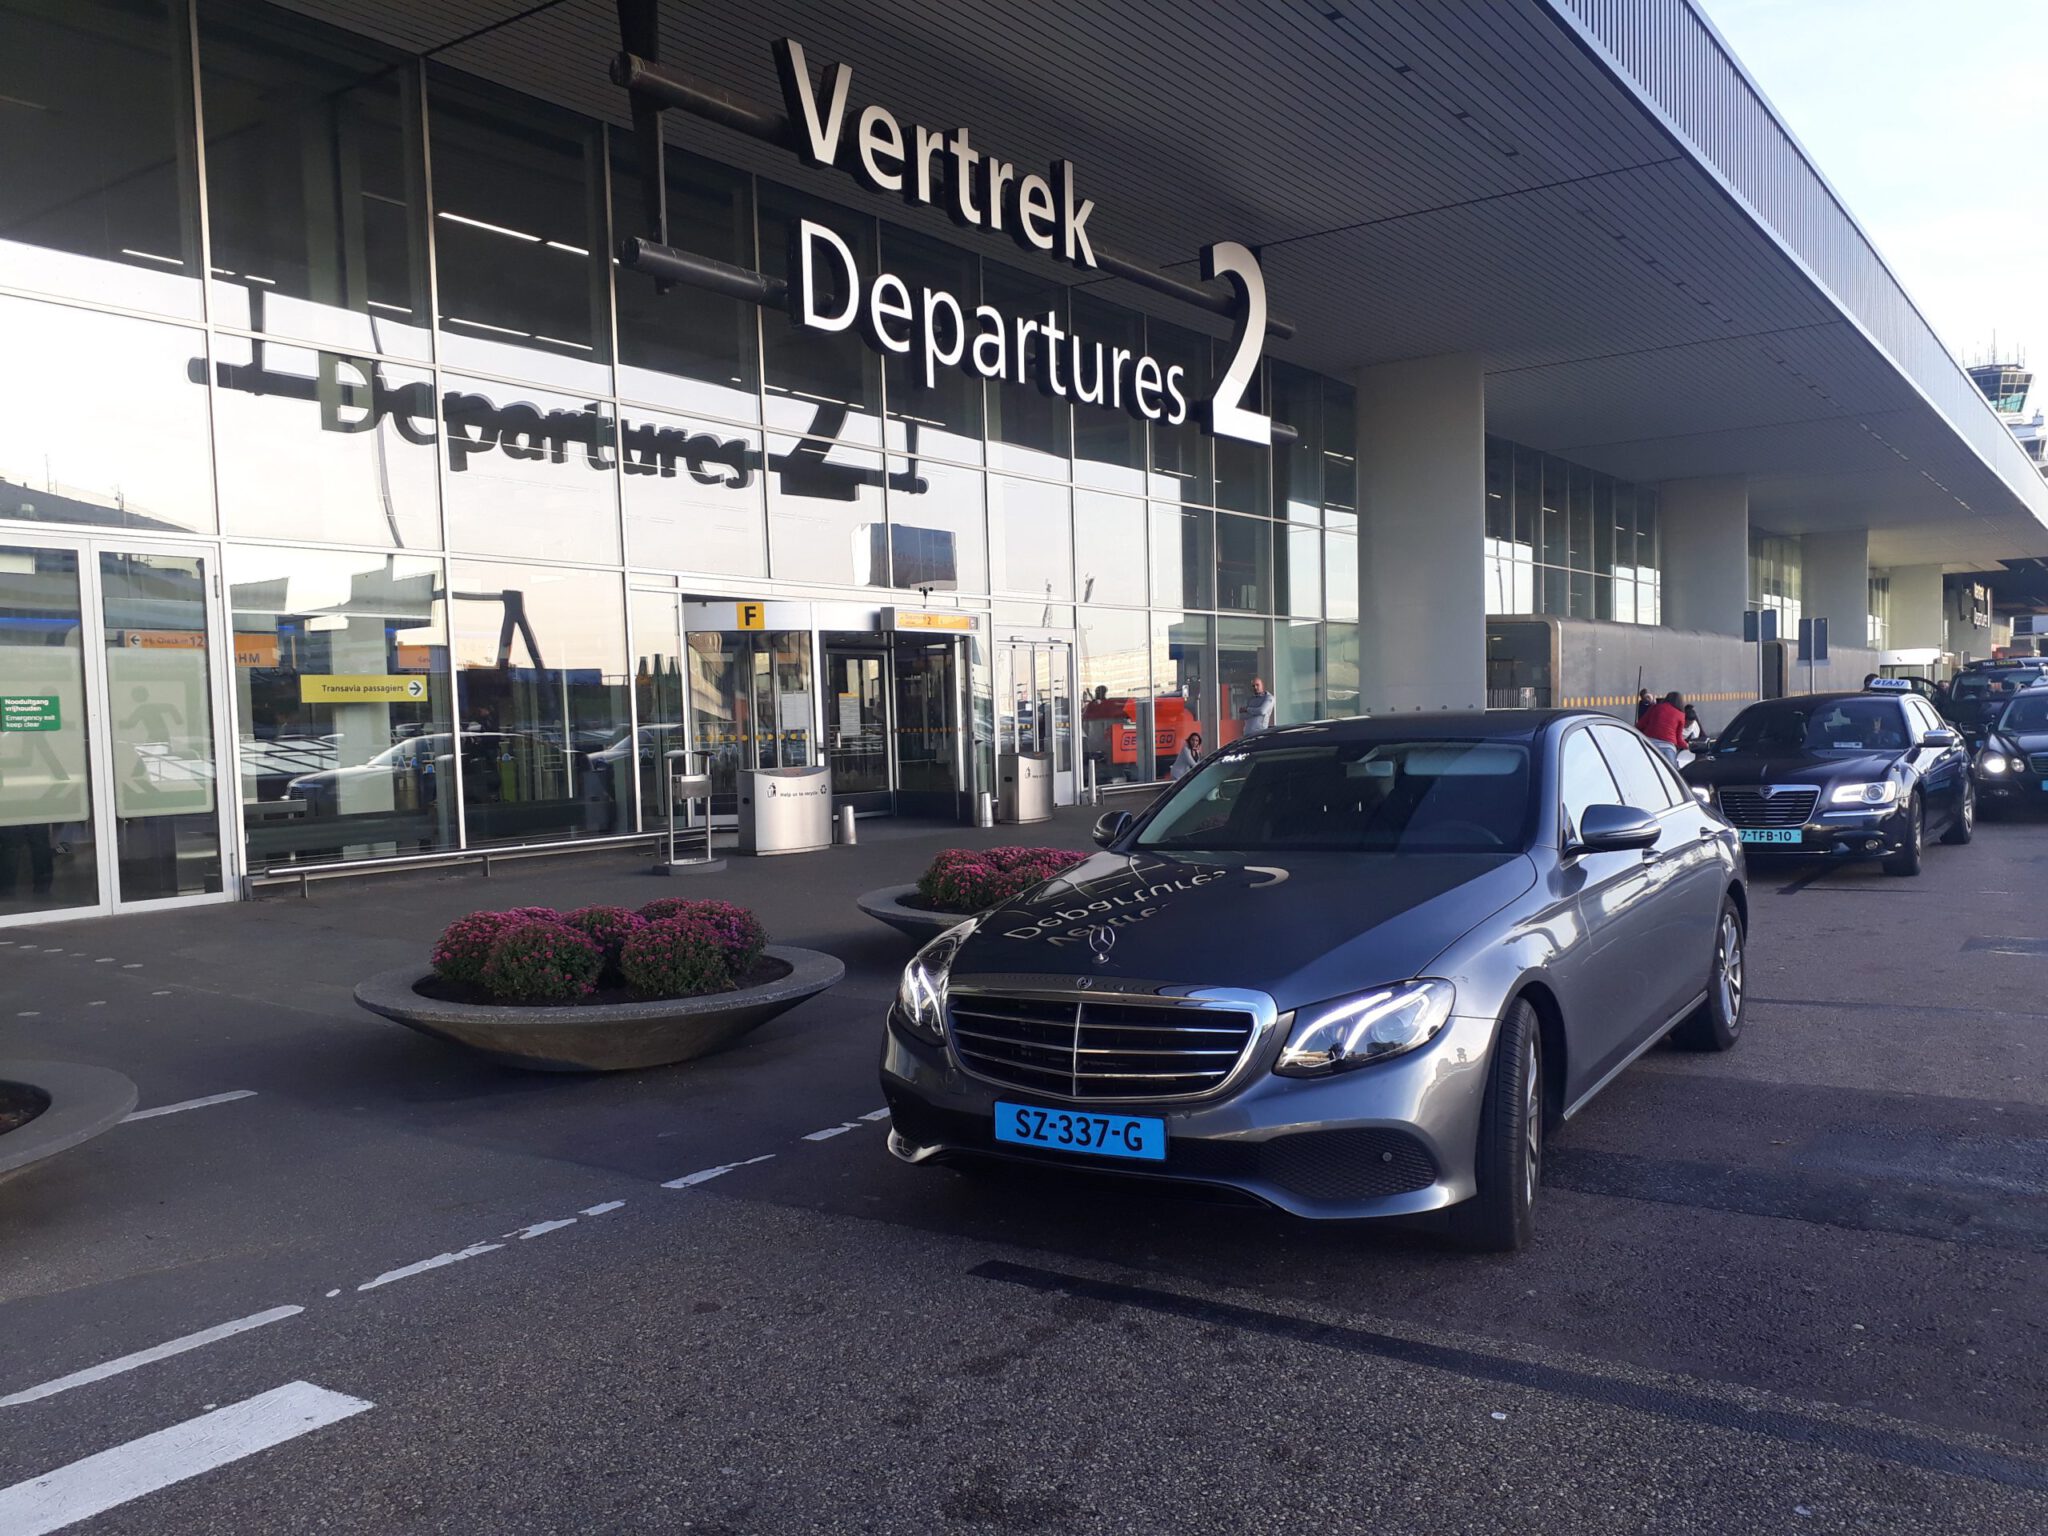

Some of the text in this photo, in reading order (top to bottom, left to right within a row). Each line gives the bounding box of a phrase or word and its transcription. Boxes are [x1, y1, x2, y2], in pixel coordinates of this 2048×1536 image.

[784, 36, 1098, 269] Vertrek
[799, 218, 1187, 425] Departures
[1210, 240, 1271, 446] 2
[744, 606, 757, 626] F
[321, 684, 404, 693] Transavia passagiers
[1741, 830, 1792, 841] 7-TFB-10
[1015, 1108, 1143, 1152] SZ-337-G
